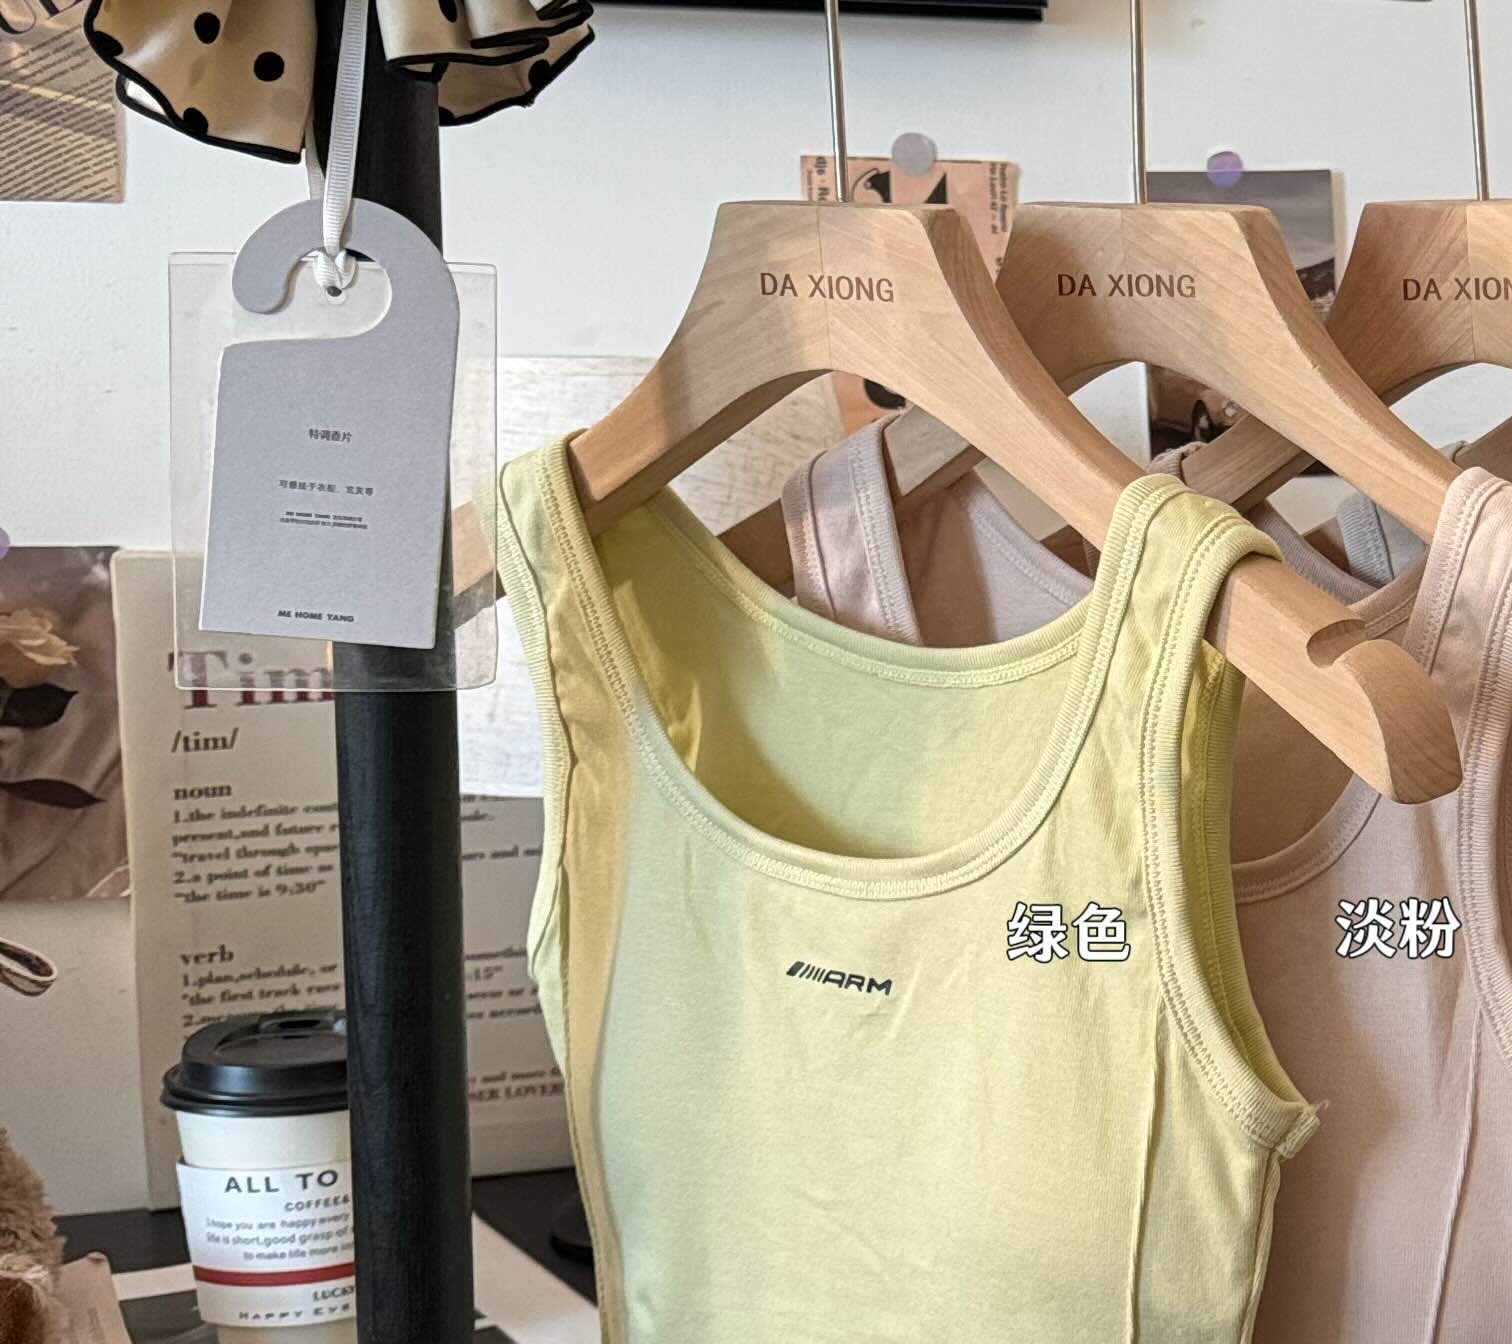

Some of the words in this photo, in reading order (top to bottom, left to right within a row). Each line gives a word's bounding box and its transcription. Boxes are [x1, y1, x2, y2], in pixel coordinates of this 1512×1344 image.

[761, 273, 799, 297] DA
[808, 275, 893, 302] XIONG
[1058, 274, 1097, 296] DA
[1108, 274, 1196, 297] XIONG
[1403, 278, 1442, 301] DA
[173, 785, 232, 801] noun
[180, 944, 235, 966] verb
[224, 1176, 280, 1194] ALL
[296, 1169, 338, 1191] TO
